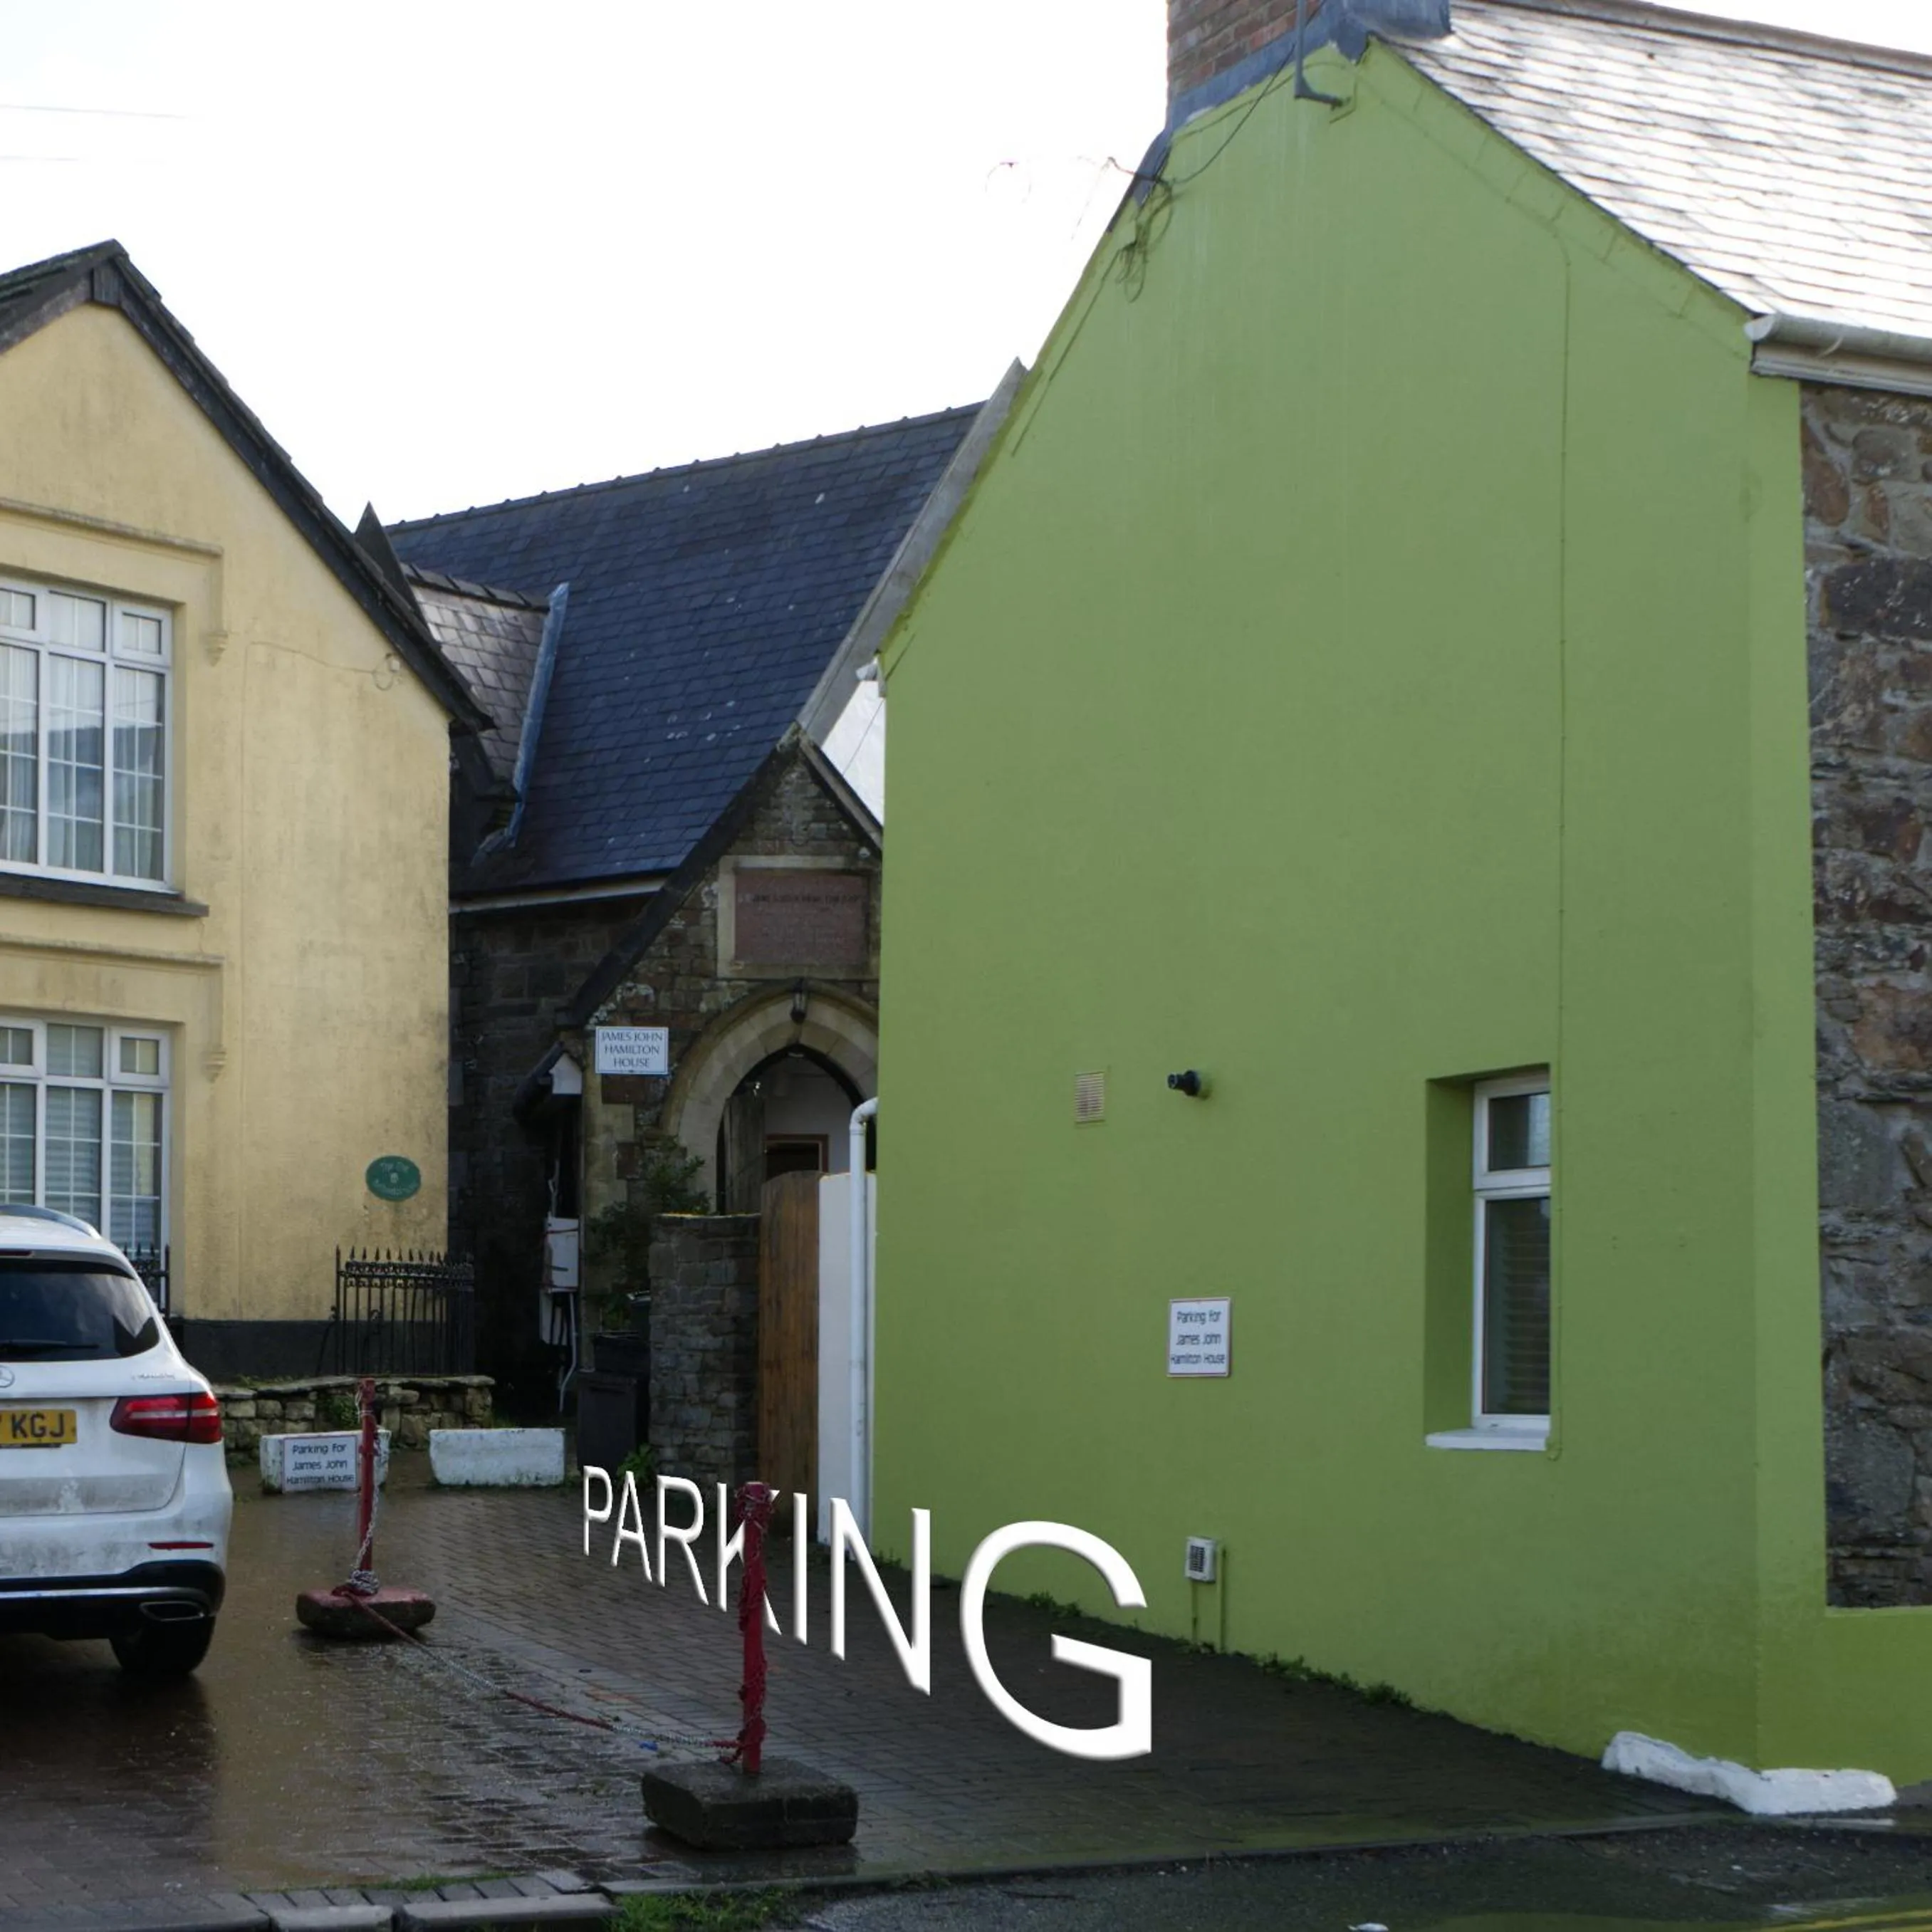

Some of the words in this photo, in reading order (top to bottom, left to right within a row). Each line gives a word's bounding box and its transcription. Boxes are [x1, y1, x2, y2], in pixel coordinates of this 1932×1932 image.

[602, 1032, 632, 1041] JAMES
[634, 1032, 663, 1041] JOHN
[605, 1045, 659, 1055] HAMILTON
[614, 1058, 649, 1067] HOUSE
[1176, 1310, 1206, 1325] Parking
[1176, 1334, 1201, 1345] James
[1202, 1332, 1222, 1345] John
[1203, 1353, 1226, 1364] House
[11, 1412, 64, 1438] KGJ
[293, 1444, 329, 1455] Parking
[292, 1461, 322, 1471] James
[325, 1459, 348, 1470] John
[286, 1475, 325, 1485] Hamilton
[328, 1473, 355, 1483] House
